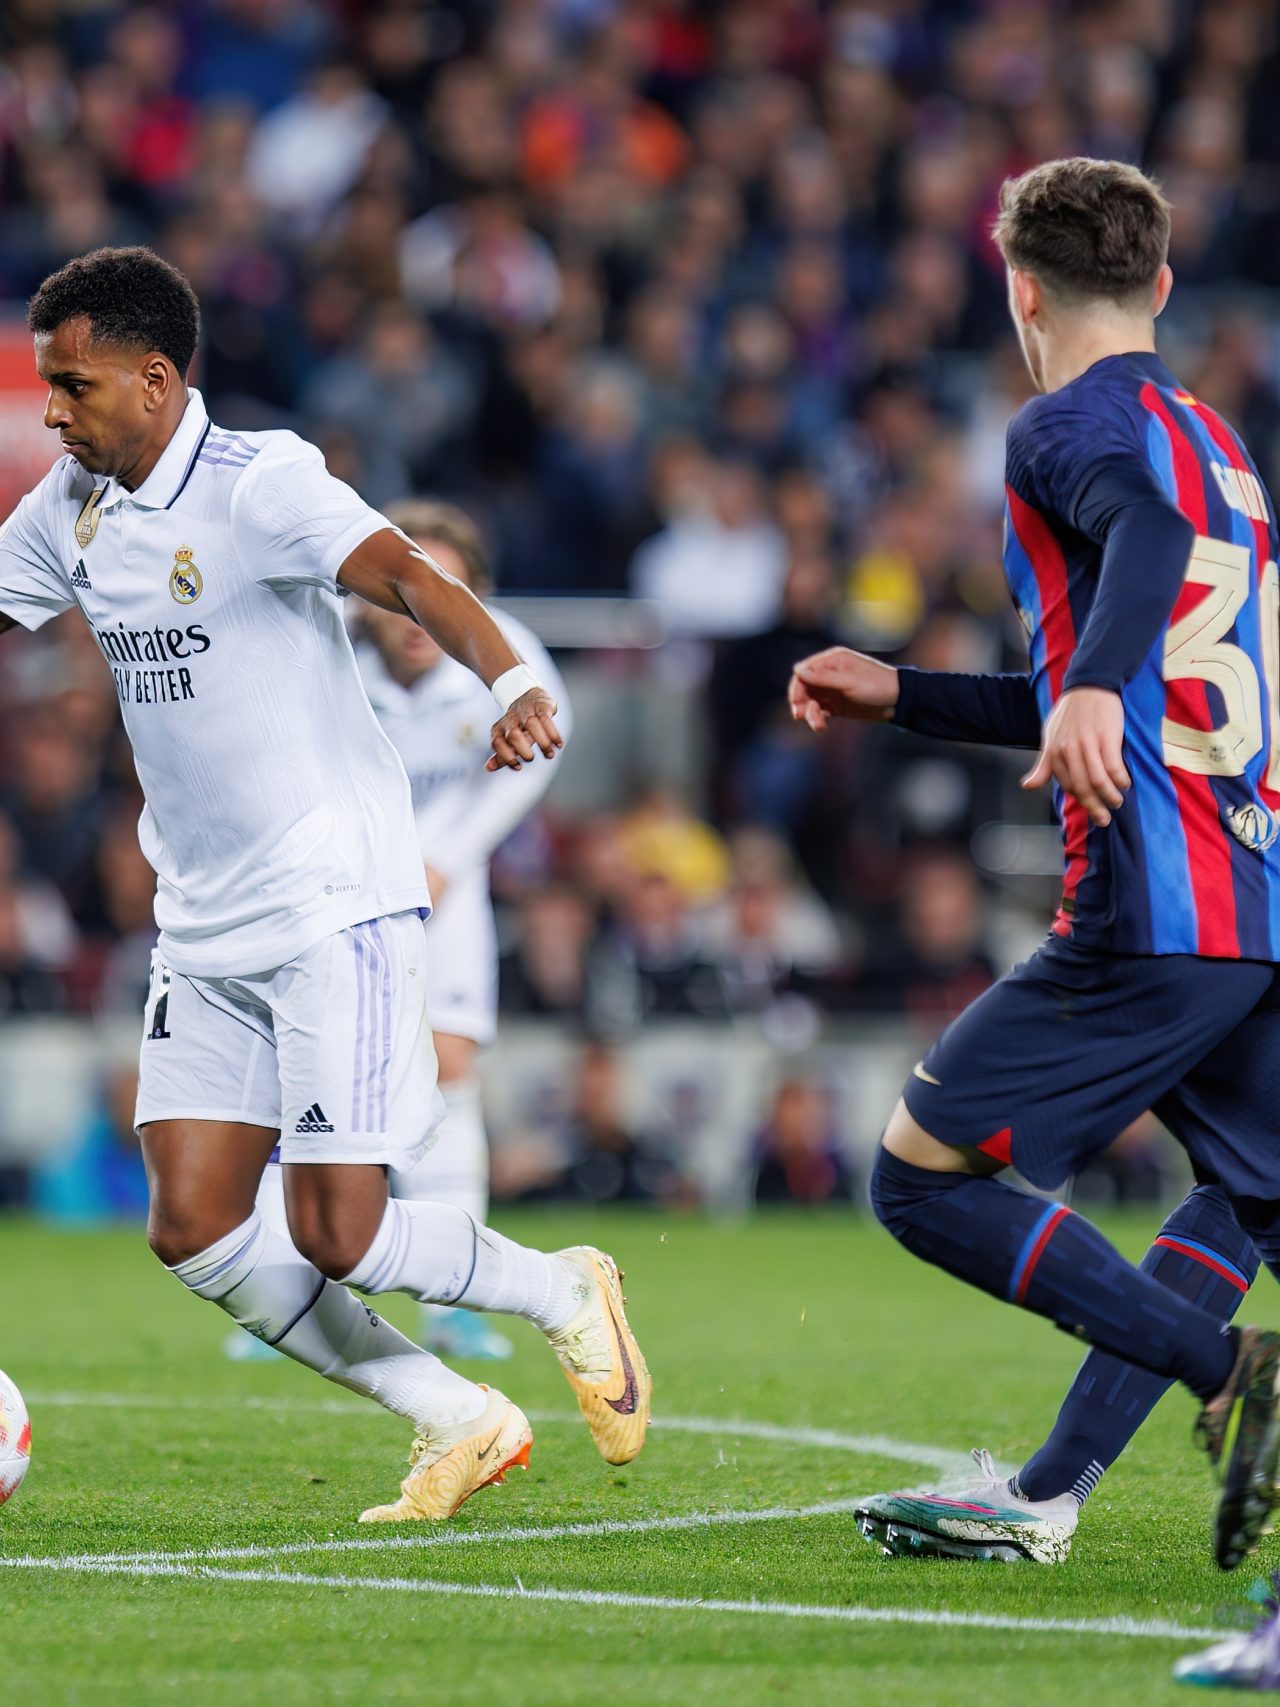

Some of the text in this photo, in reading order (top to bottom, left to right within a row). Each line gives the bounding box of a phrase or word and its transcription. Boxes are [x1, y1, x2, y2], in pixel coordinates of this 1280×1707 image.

[91, 621, 211, 662] mirates
[136, 667, 195, 703] BETTER
[296, 1123, 334, 1133] adidas
